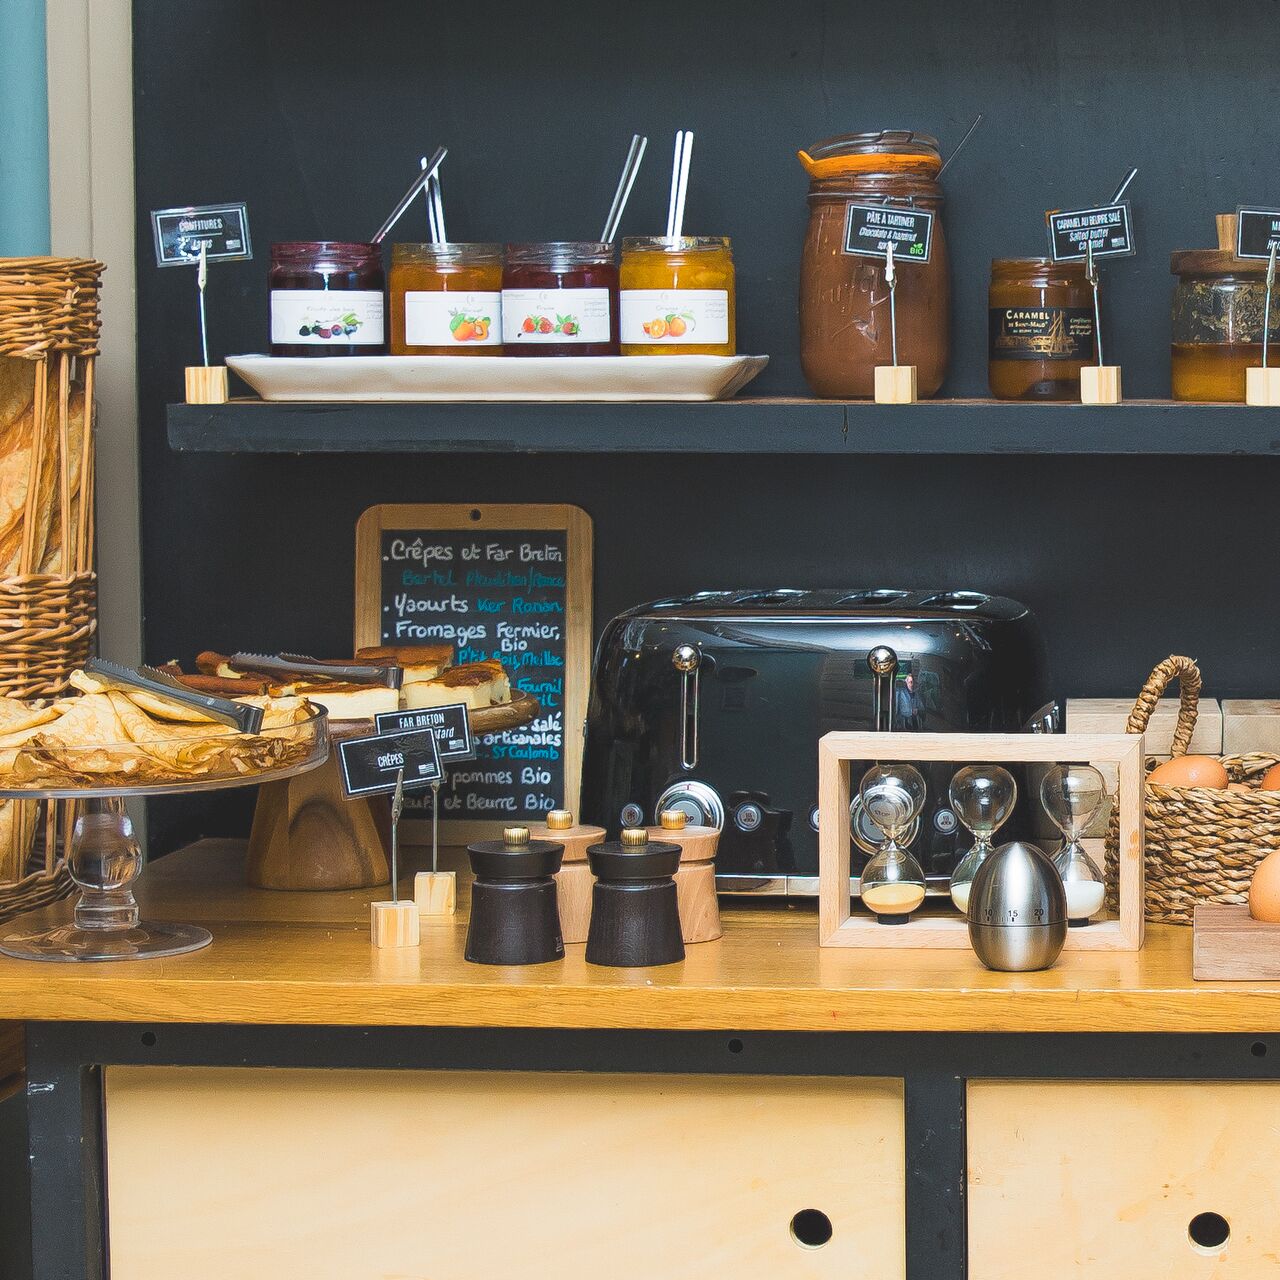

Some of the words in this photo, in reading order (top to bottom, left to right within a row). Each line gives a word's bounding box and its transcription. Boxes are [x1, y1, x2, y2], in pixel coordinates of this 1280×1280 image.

[887, 214, 914, 227] TARTINER
[1057, 217, 1081, 230] CARAMEL
[1081, 216, 1089, 227] AU
[1089, 213, 1109, 226] BEURRE
[1109, 210, 1121, 223] SALÉ
[859, 227, 887, 239] Chocolate
[887, 230, 892, 239] &
[892, 232, 917, 242] hazelnut
[1069, 230, 1089, 242] Salted
[1090, 228, 1109, 239] butter
[910, 247, 924, 255] BIO
[1006, 310, 1050, 320] CARAMEL
[391, 537, 453, 568] Crêpes
[462, 543, 482, 560] et
[487, 543, 514, 561] Far
[519, 543, 562, 562] Breton
[394, 593, 469, 617] Yaourts
[395, 620, 487, 648] Fromages
[501, 638, 528, 652] Bio
[399, 717, 414, 728] FAR
[416, 713, 445, 726] BRETON
[531, 711, 562, 732] salé
[483, 730, 562, 747] artisanales
[378, 752, 404, 768] CRÊPES
[452, 771, 513, 791] pommes
[521, 766, 551, 785] Bio
[444, 794, 463, 810] et
[466, 793, 518, 811] Beurre
[524, 793, 555, 811] Bio
[984, 908, 992, 917] 10
[1034, 908, 1044, 916] 20
